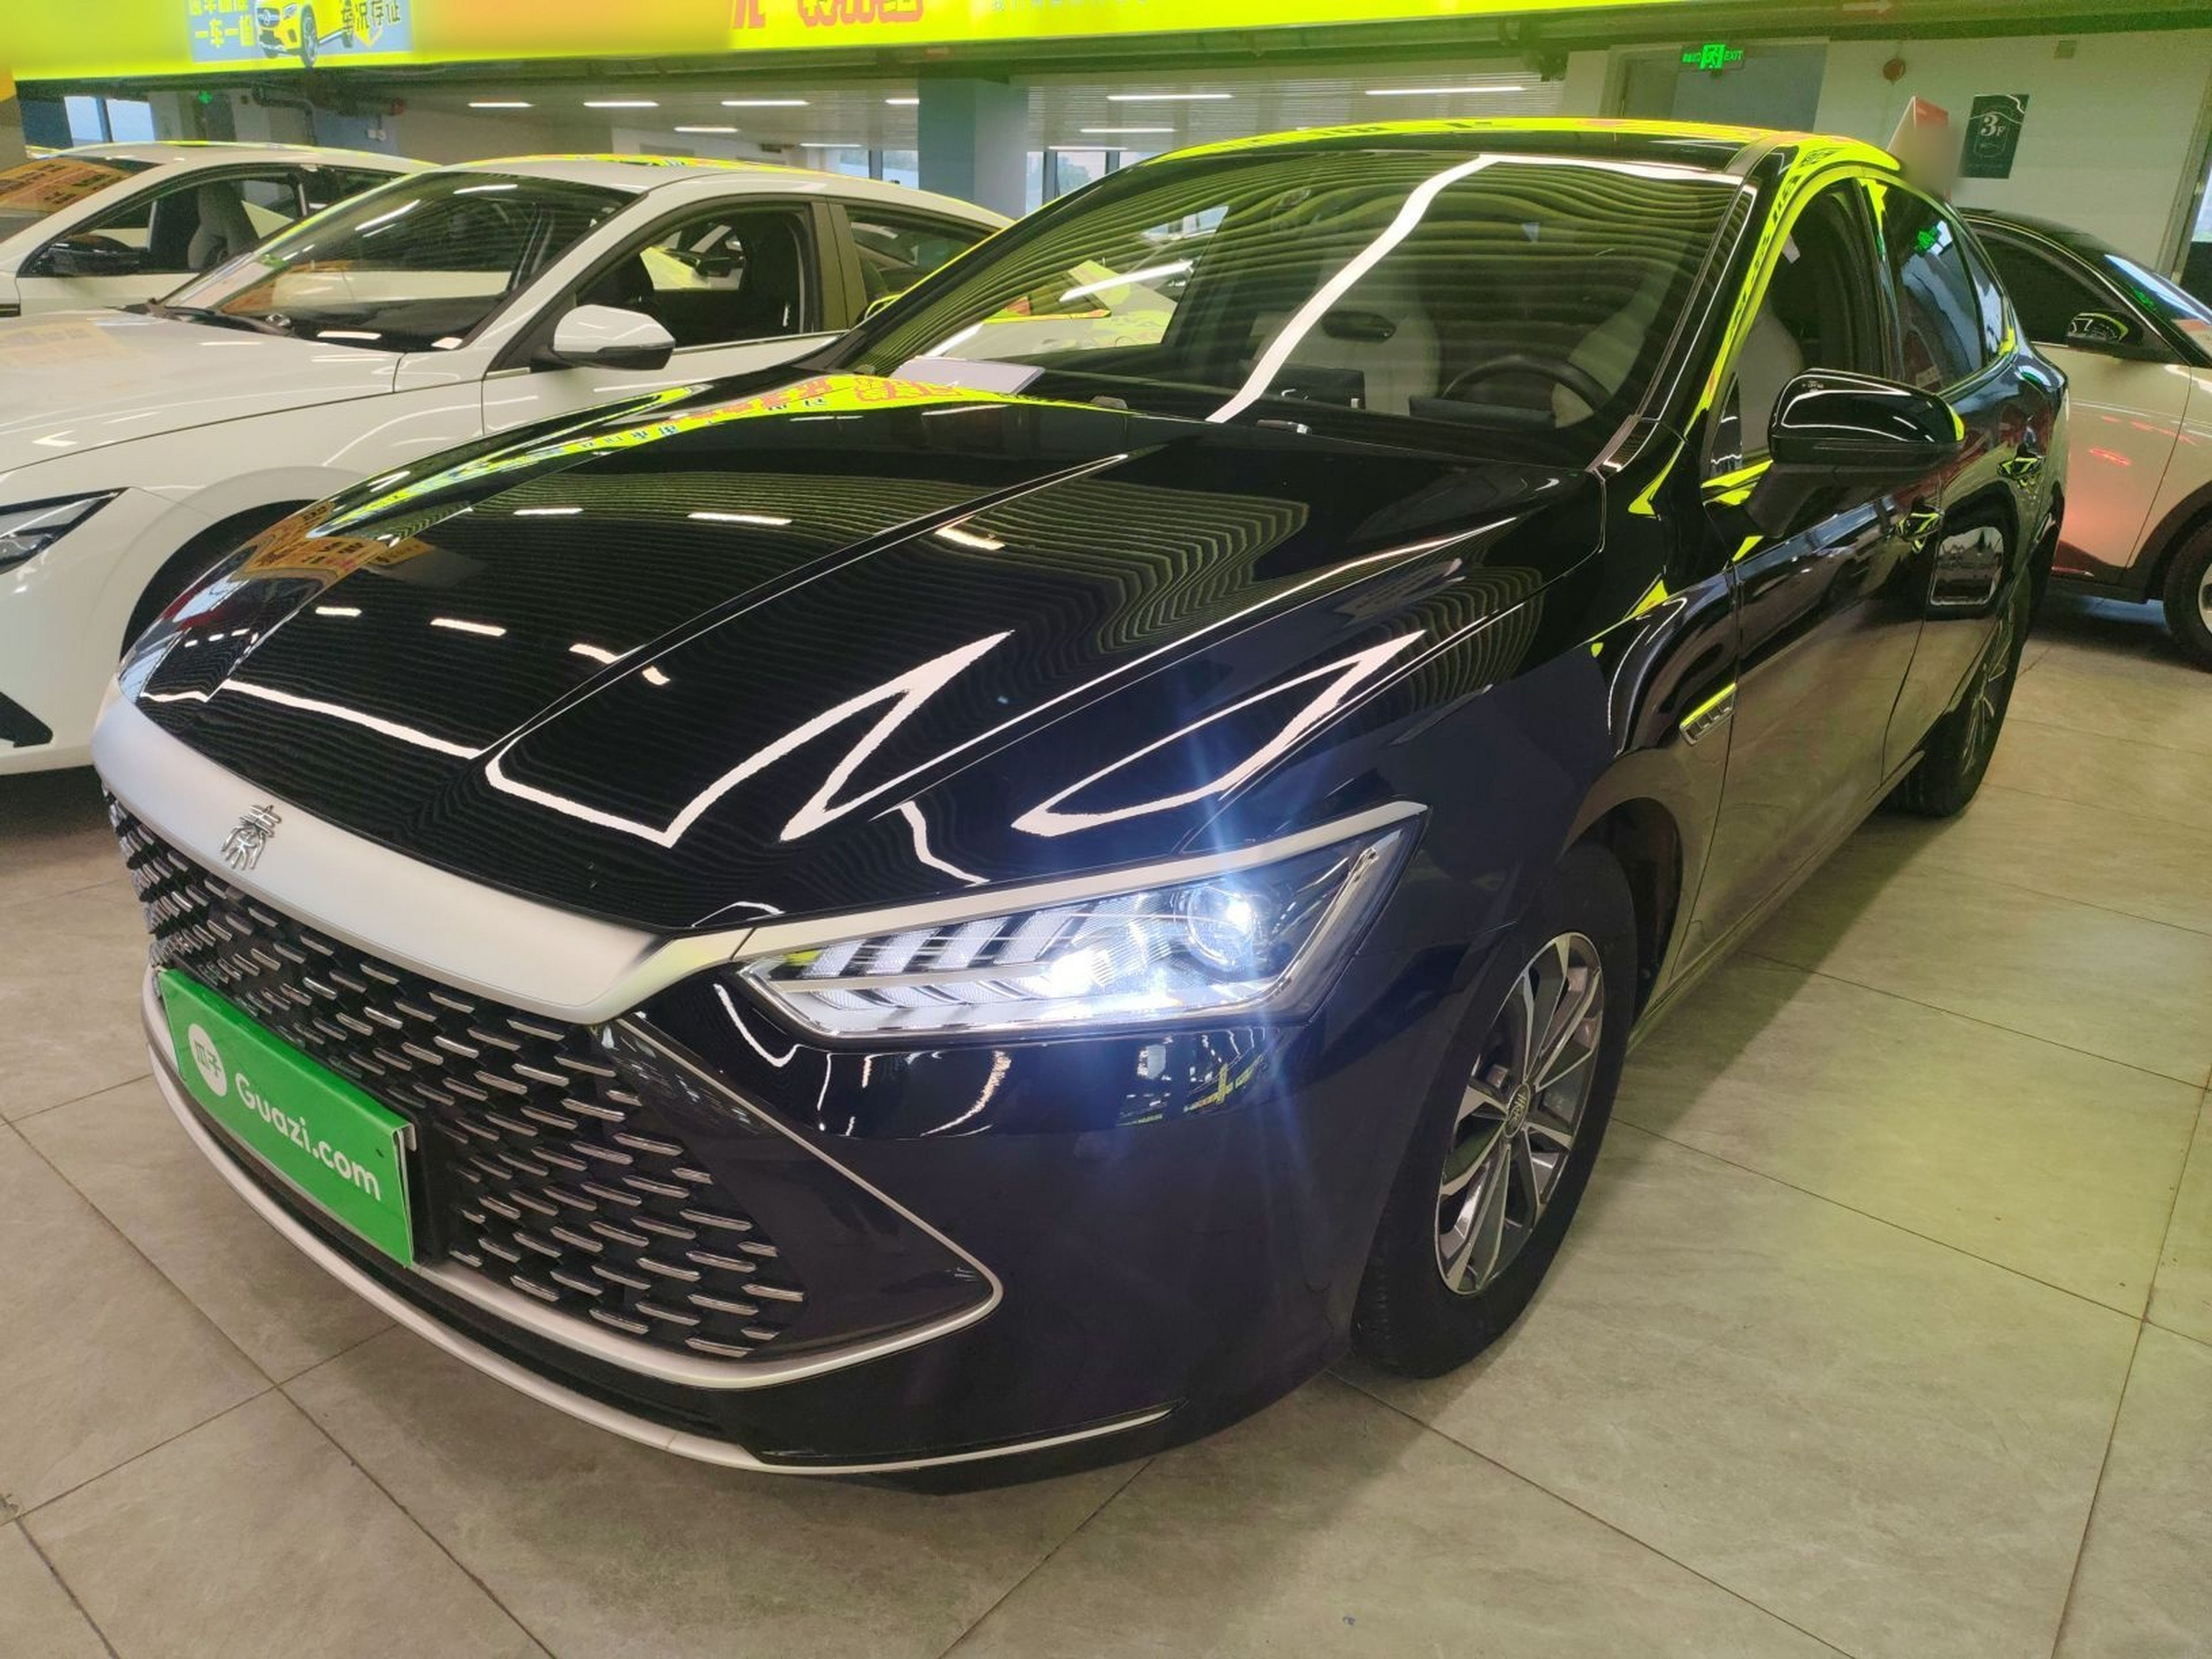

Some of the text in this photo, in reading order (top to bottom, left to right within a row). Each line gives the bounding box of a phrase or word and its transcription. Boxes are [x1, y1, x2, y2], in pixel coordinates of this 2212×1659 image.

[1724, 50, 1743, 61] EXIT
[1980, 114, 2006, 136] 3F
[235, 1073, 381, 1202] Guazi.com
